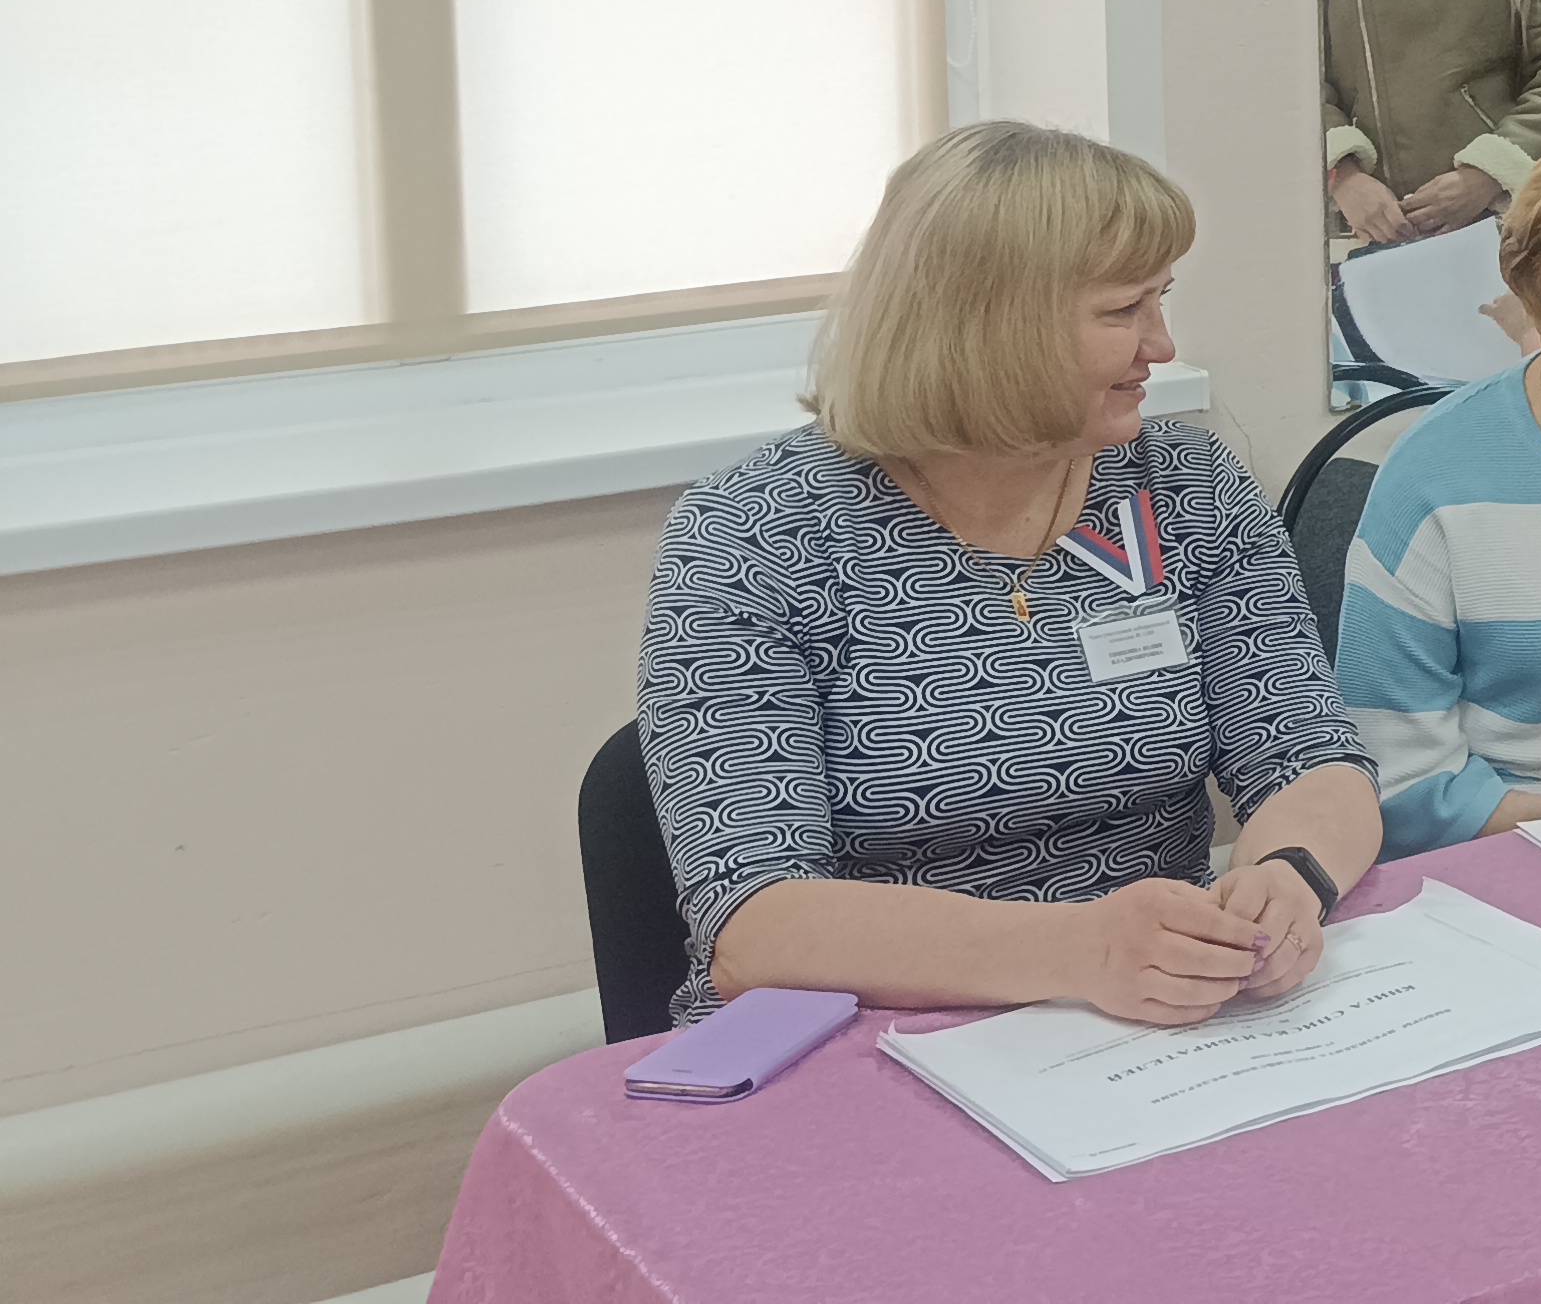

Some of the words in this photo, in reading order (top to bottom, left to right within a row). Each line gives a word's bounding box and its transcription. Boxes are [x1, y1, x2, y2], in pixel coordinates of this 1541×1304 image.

[1349, 984, 1416, 1009] КНИГА
[1261, 1010, 1345, 1038] СПИСКА
[1107, 1034, 1258, 1082] ИЗБИРАТЕЛЕЙ
